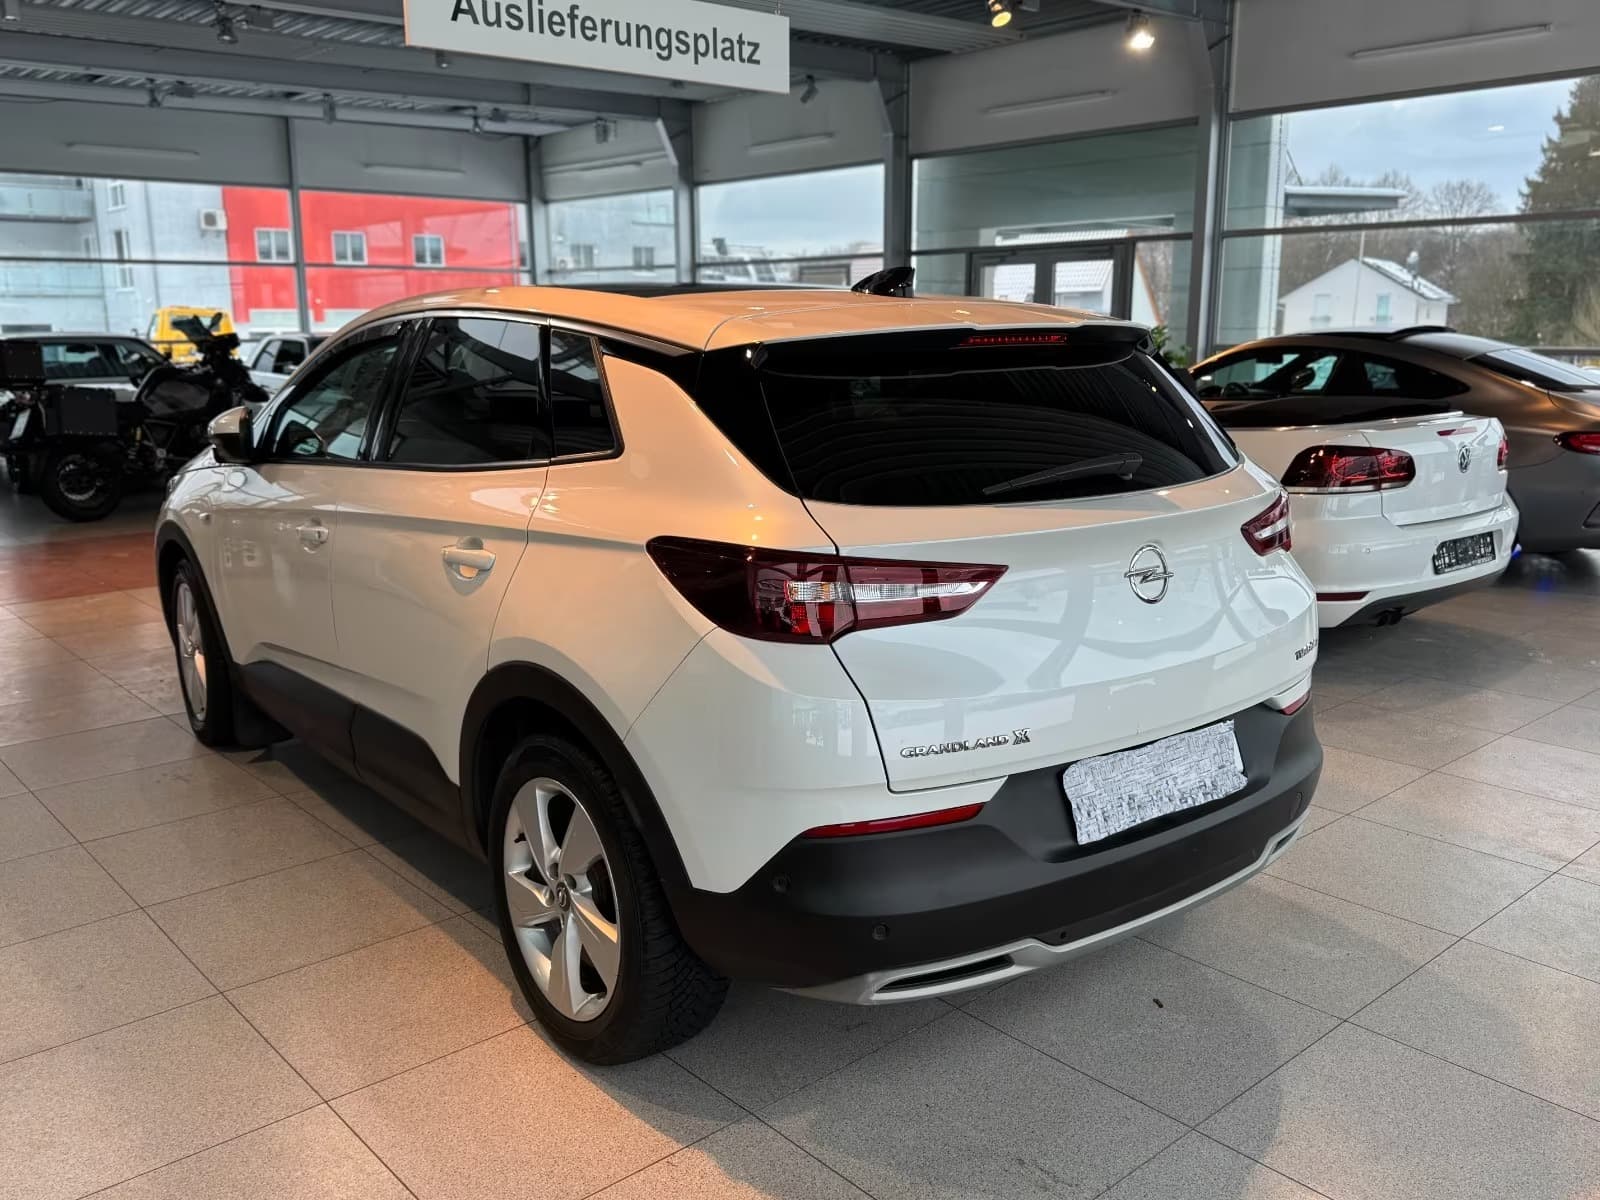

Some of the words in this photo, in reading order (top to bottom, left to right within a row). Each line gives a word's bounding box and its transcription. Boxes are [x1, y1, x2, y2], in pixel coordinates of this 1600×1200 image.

[450, 0, 761, 65] Auslieferungsplatz
[900, 735, 1009, 758] GRANDLAND
[1012, 728, 1031, 745] X
